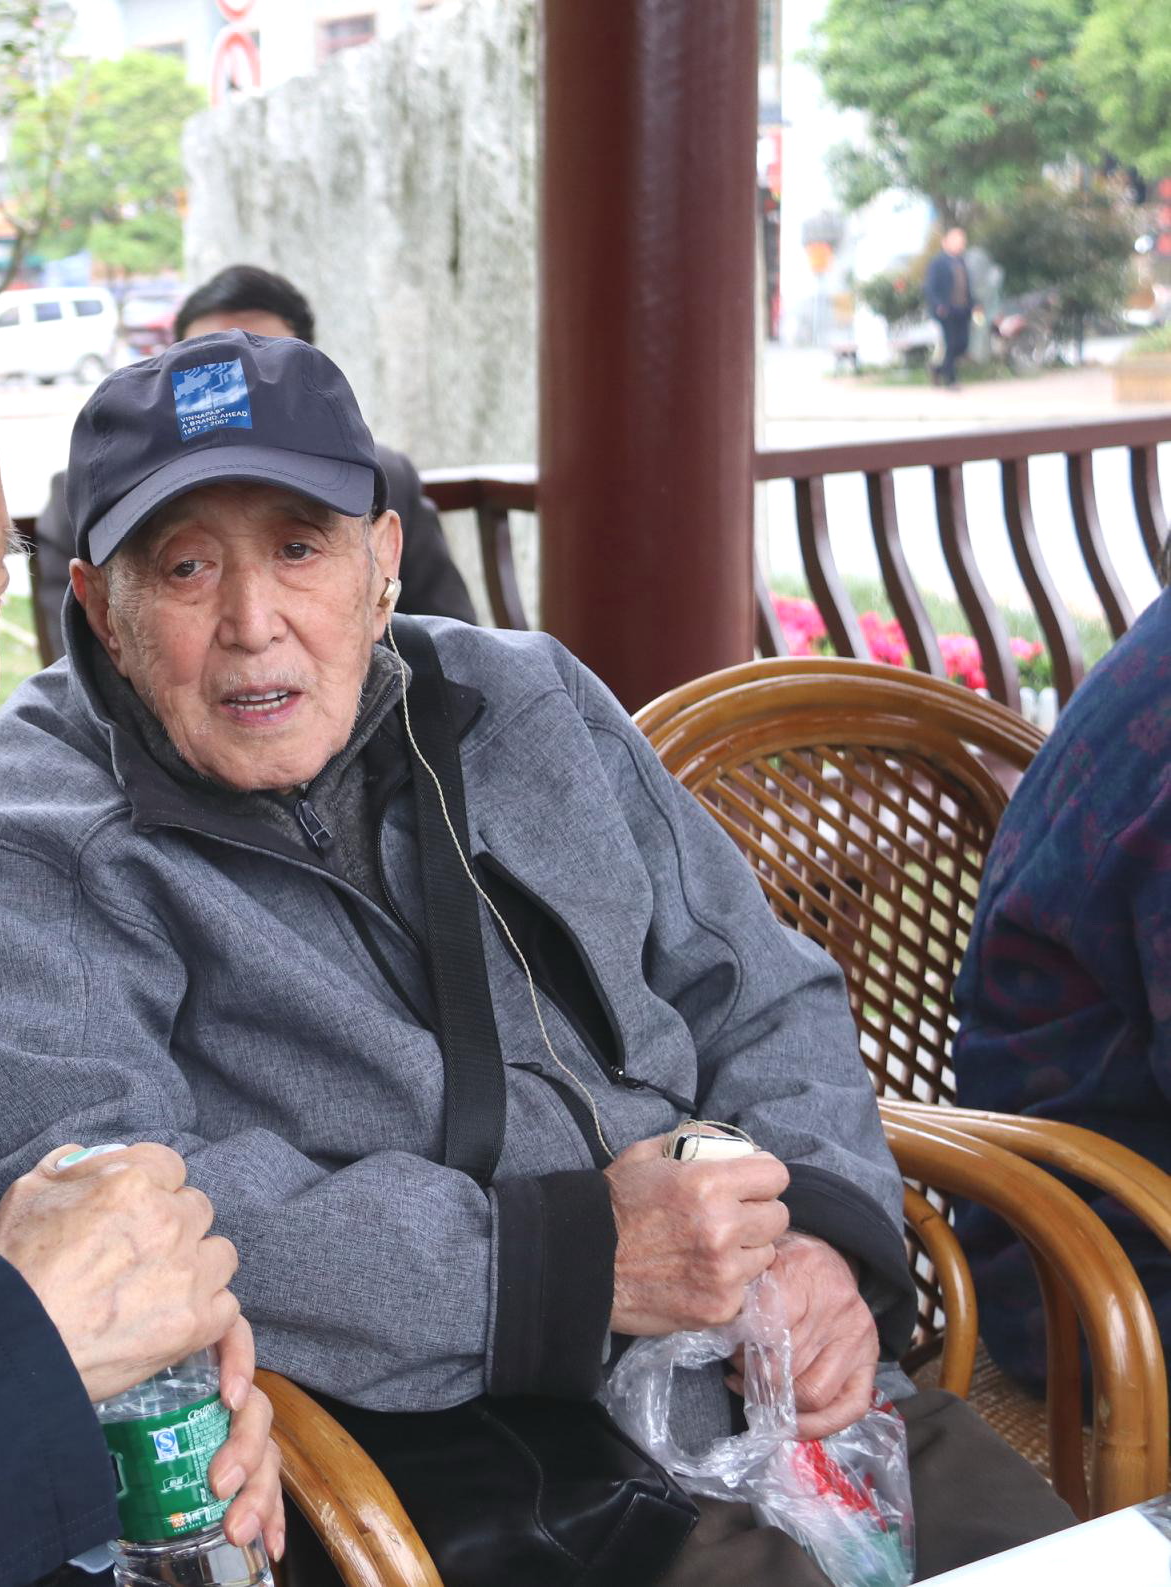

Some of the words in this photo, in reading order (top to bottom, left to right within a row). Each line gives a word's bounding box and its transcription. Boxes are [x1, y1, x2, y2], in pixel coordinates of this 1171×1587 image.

[183, 425, 201, 436] 1957
[210, 418, 229, 427] 2007
[189, 415, 218, 427] BRAND
[220, 410, 248, 419] AHEAD
